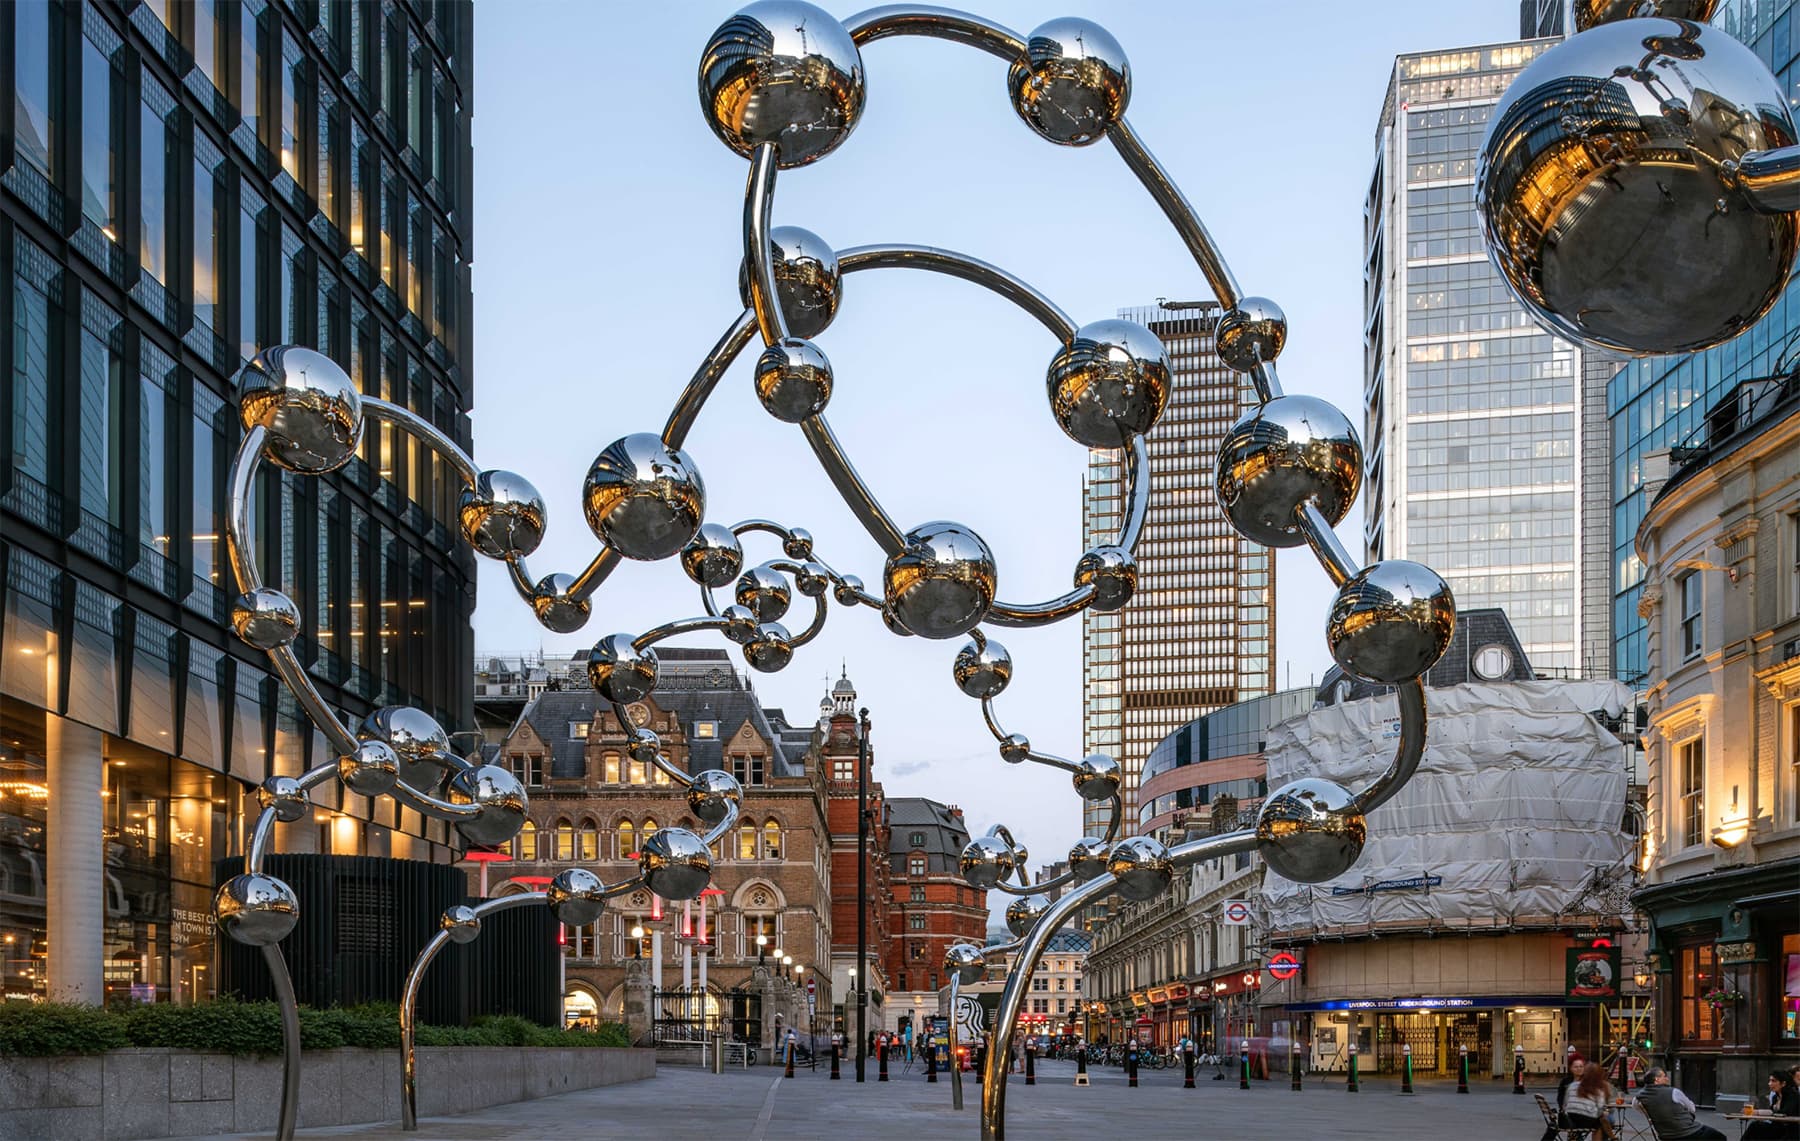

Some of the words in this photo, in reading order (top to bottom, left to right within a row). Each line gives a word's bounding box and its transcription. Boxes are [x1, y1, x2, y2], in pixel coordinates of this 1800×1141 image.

[172, 909, 187, 920] THE
[188, 911, 205, 922] BEST
[172, 920, 181, 930] IN
[182, 921, 204, 934] TOWN
[205, 925, 212, 936] IS
